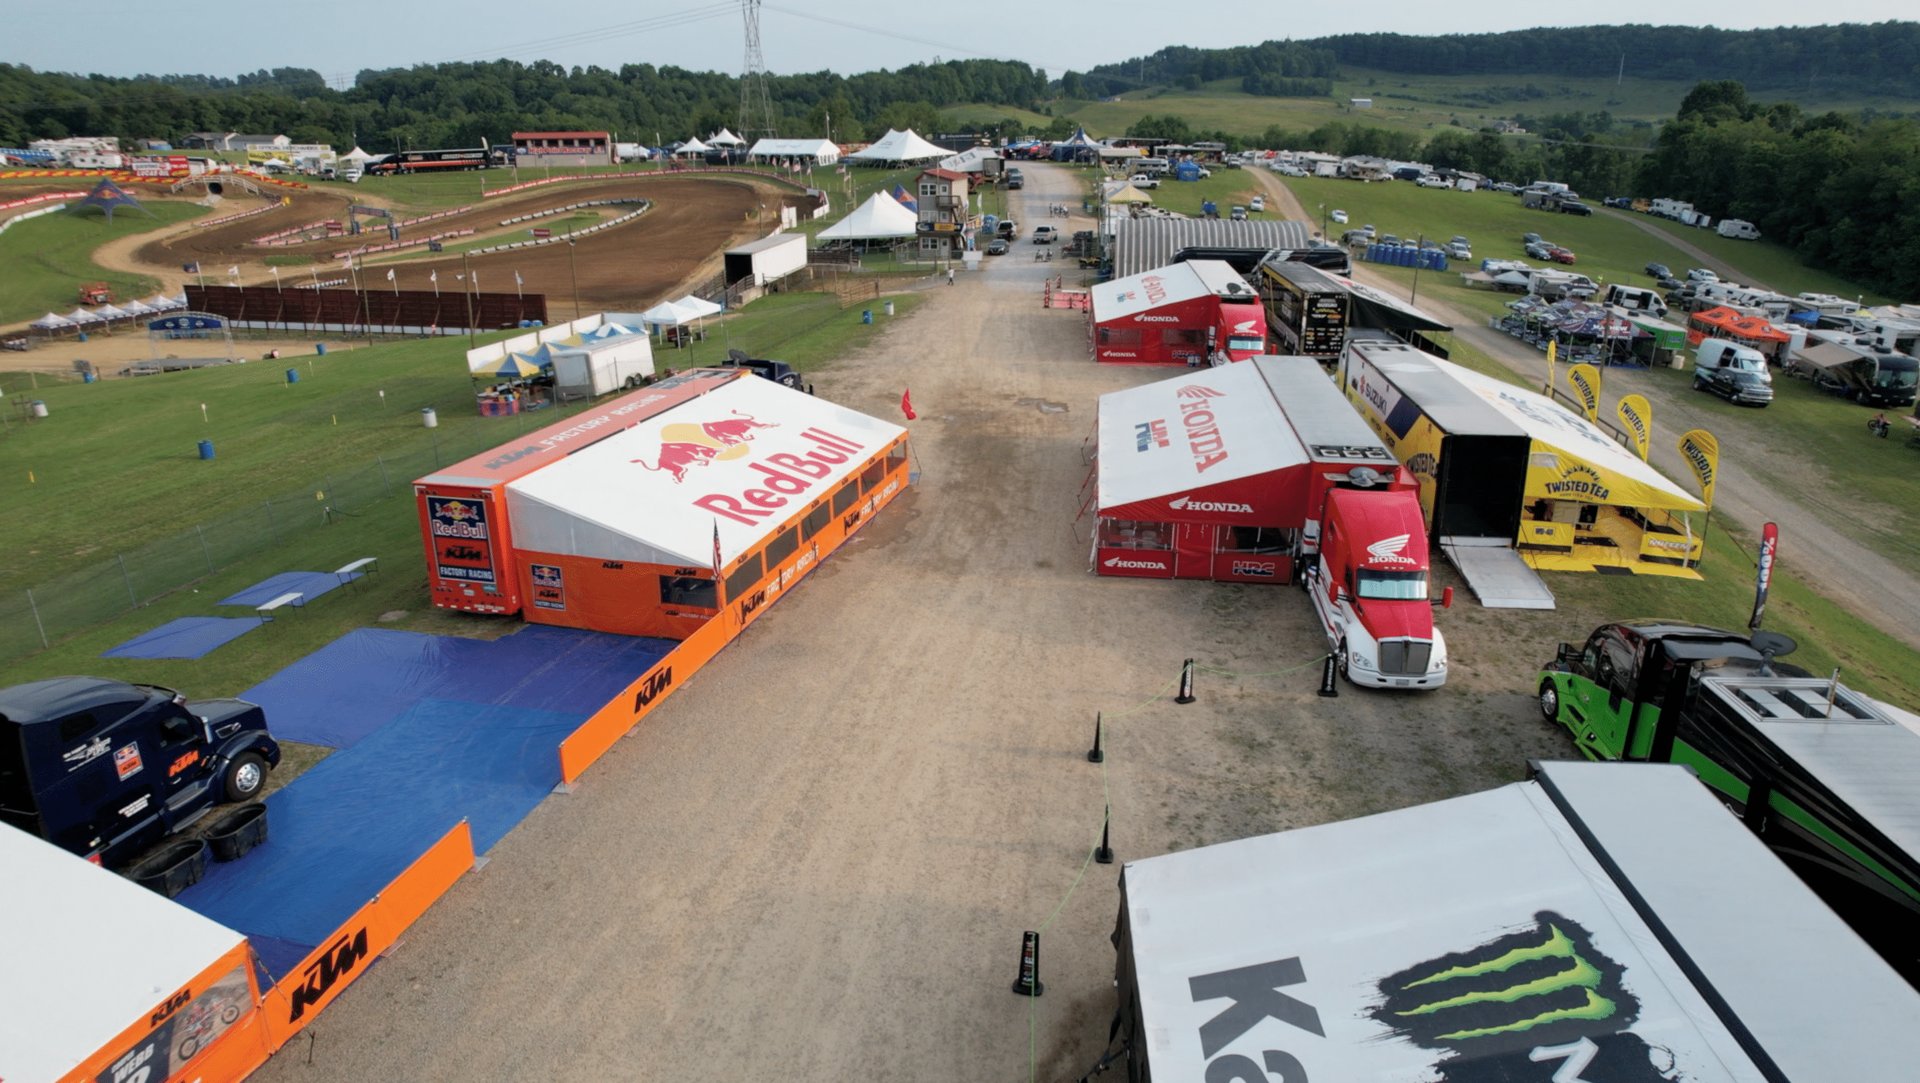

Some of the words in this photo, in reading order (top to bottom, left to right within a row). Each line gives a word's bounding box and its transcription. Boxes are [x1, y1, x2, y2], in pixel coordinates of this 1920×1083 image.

[1143, 315, 1180, 323] HONDA
[1571, 370, 1592, 397] TWISTED
[1365, 382, 1387, 415] SUZUKI
[1620, 402, 1644, 430] TWISTED
[1180, 399, 1229, 474] HONDA
[1682, 439, 1710, 470] TWISTED
[1702, 469, 1712, 487] TEA
[1545, 481, 1589, 495] TWISTED
[1590, 482, 1610, 500] TEA
[1187, 501, 1254, 513] HONDA
[445, 545, 482, 559] KTM
[1116, 560, 1167, 570] HONDA
[1368, 555, 1417, 565] HONDA
[440, 566, 467, 577] FACTORY
[468, 569, 493, 580] RACING
[674, 568, 697, 577] KTM
[1232, 560, 1275, 577] HRC
[634, 665, 672, 714] KTM
[167, 750, 199, 778] KTM
[289, 926, 368, 1025] KTM
[150, 988, 191, 1028] KTM
[114, 1043, 155, 1083] WEBB
